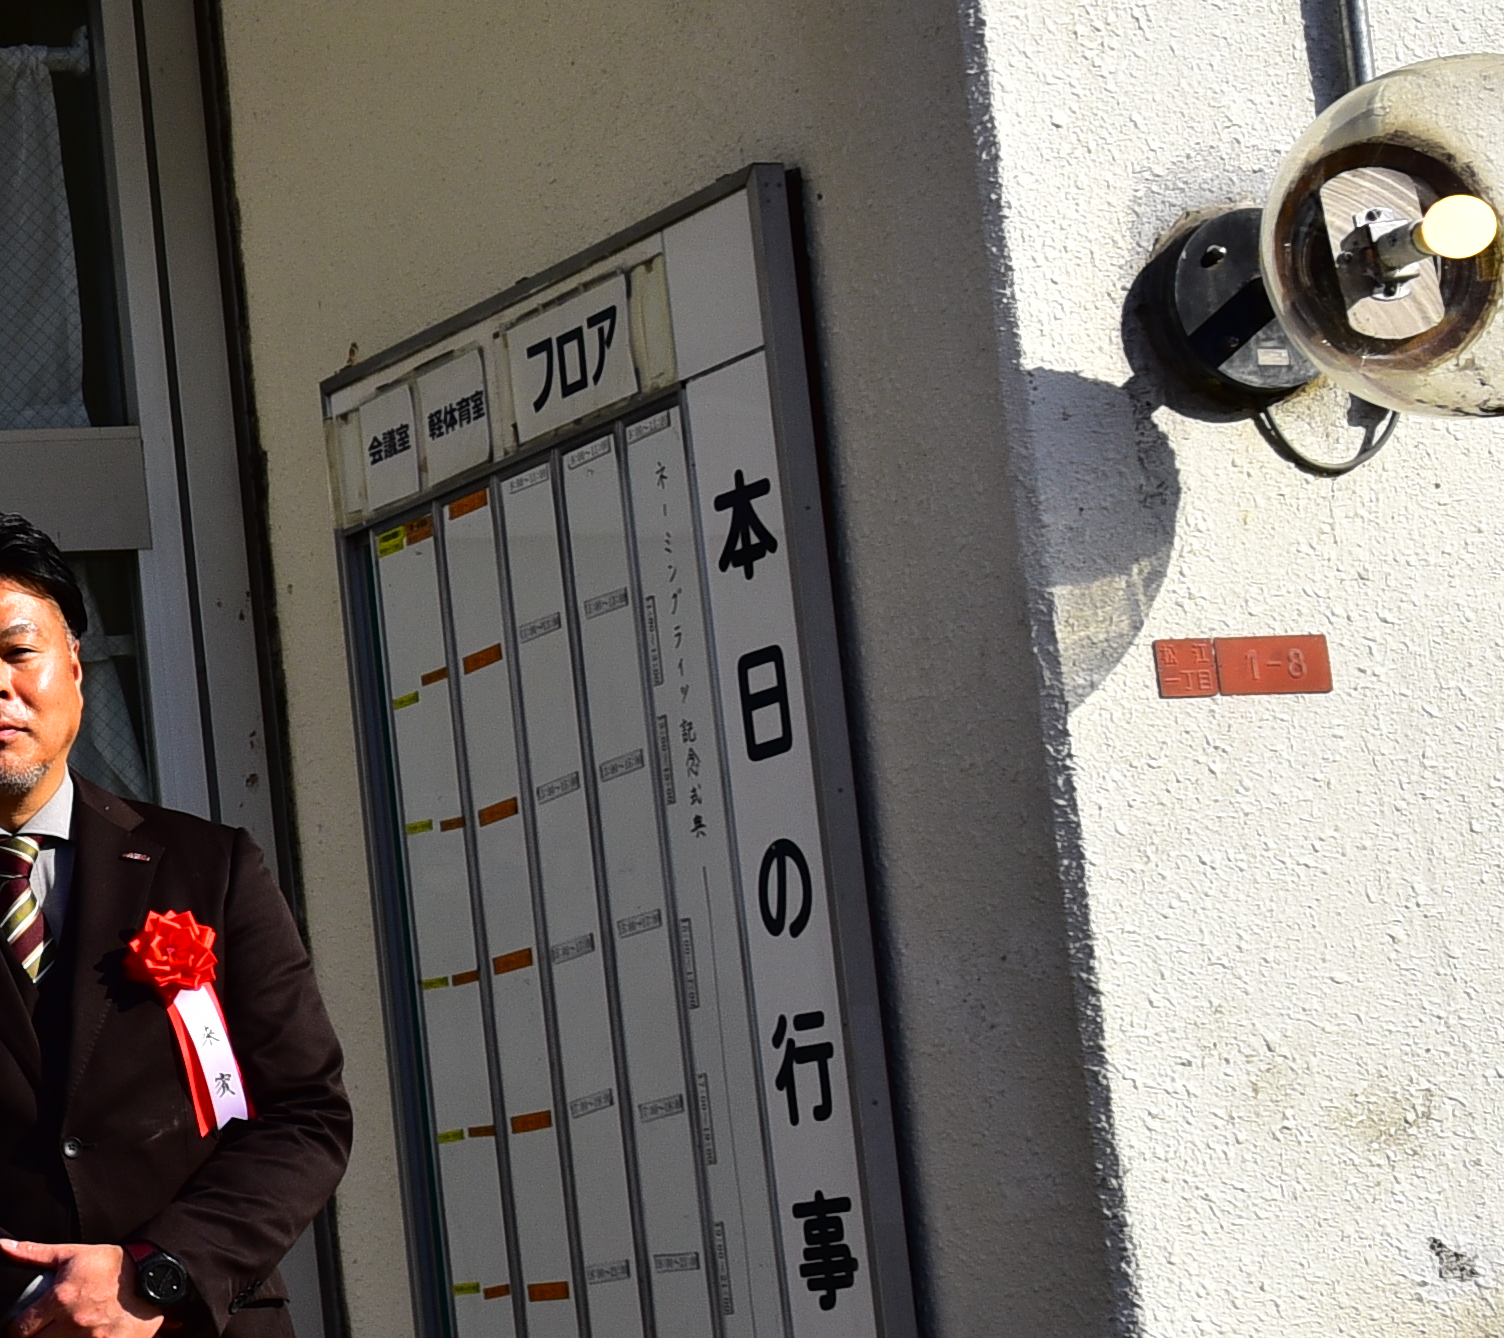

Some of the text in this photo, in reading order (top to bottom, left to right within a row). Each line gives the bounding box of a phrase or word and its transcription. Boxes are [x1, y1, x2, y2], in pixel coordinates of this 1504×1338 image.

[526, 305, 618, 414] フロア
[428, 390, 486, 441] 軽体育室
[368, 423, 411, 466] 会議室
[1245, 648, 1308, 681] 1-8
[712, 468, 859, 1313] 本日の行事
